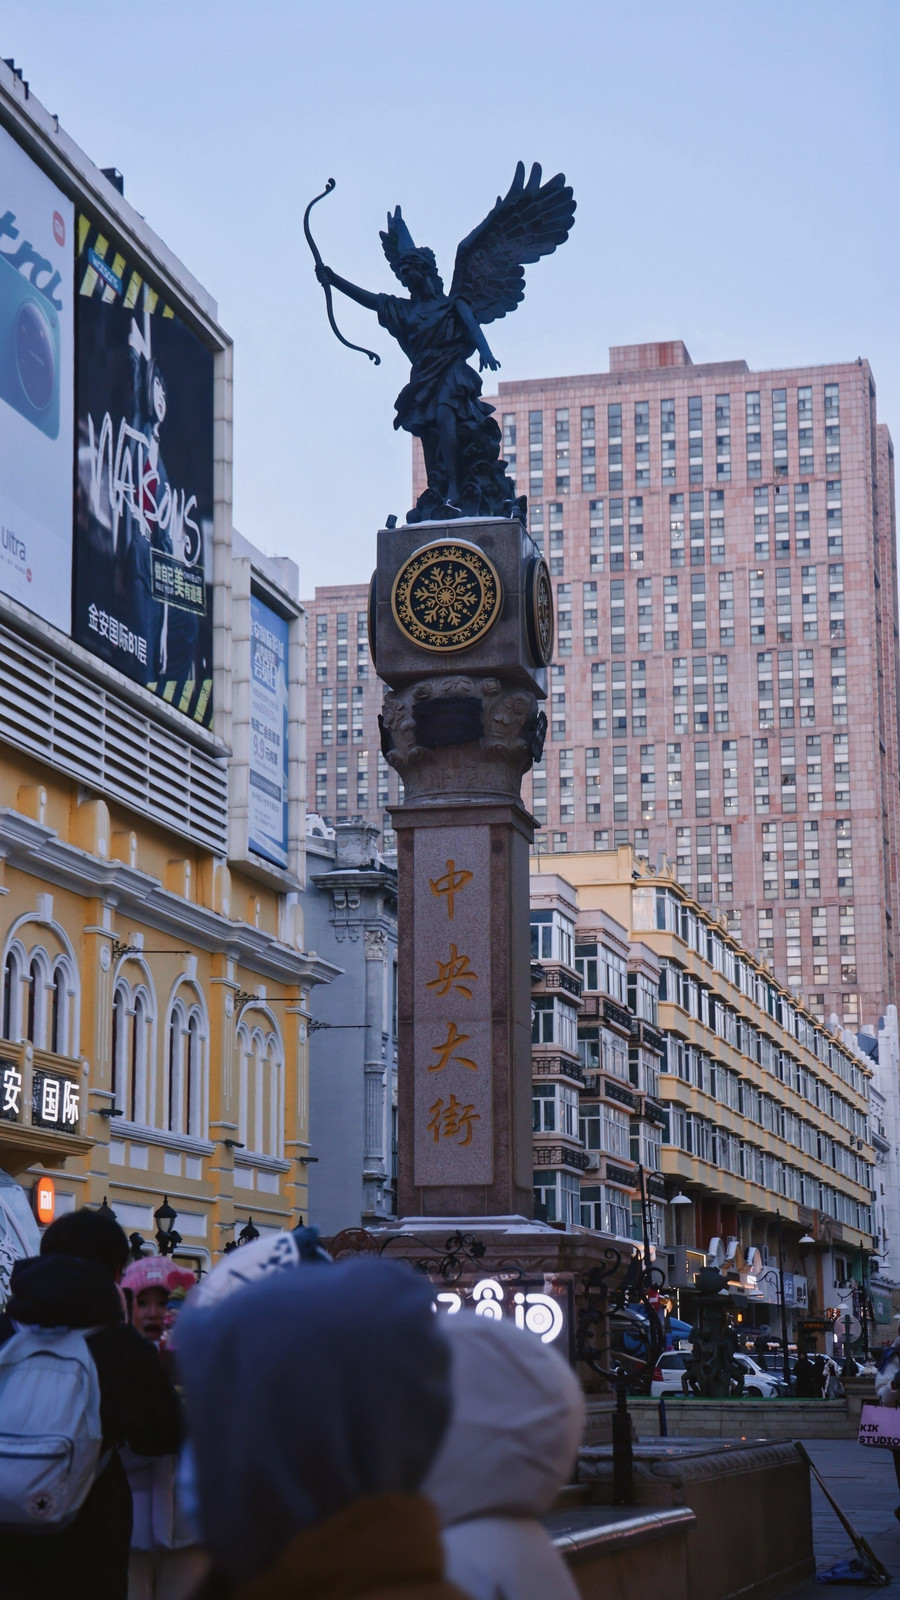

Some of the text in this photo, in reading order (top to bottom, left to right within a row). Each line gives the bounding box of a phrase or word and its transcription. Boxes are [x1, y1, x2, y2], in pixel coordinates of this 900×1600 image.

[2, 525, 26, 562] Ultra
[88, 602, 148, 666] 金安国际B1层
[426, 859, 481, 1147] 中央大街
[858, 1435, 900, 1445] STUDIO
[860, 1424, 879, 1432] KIK
